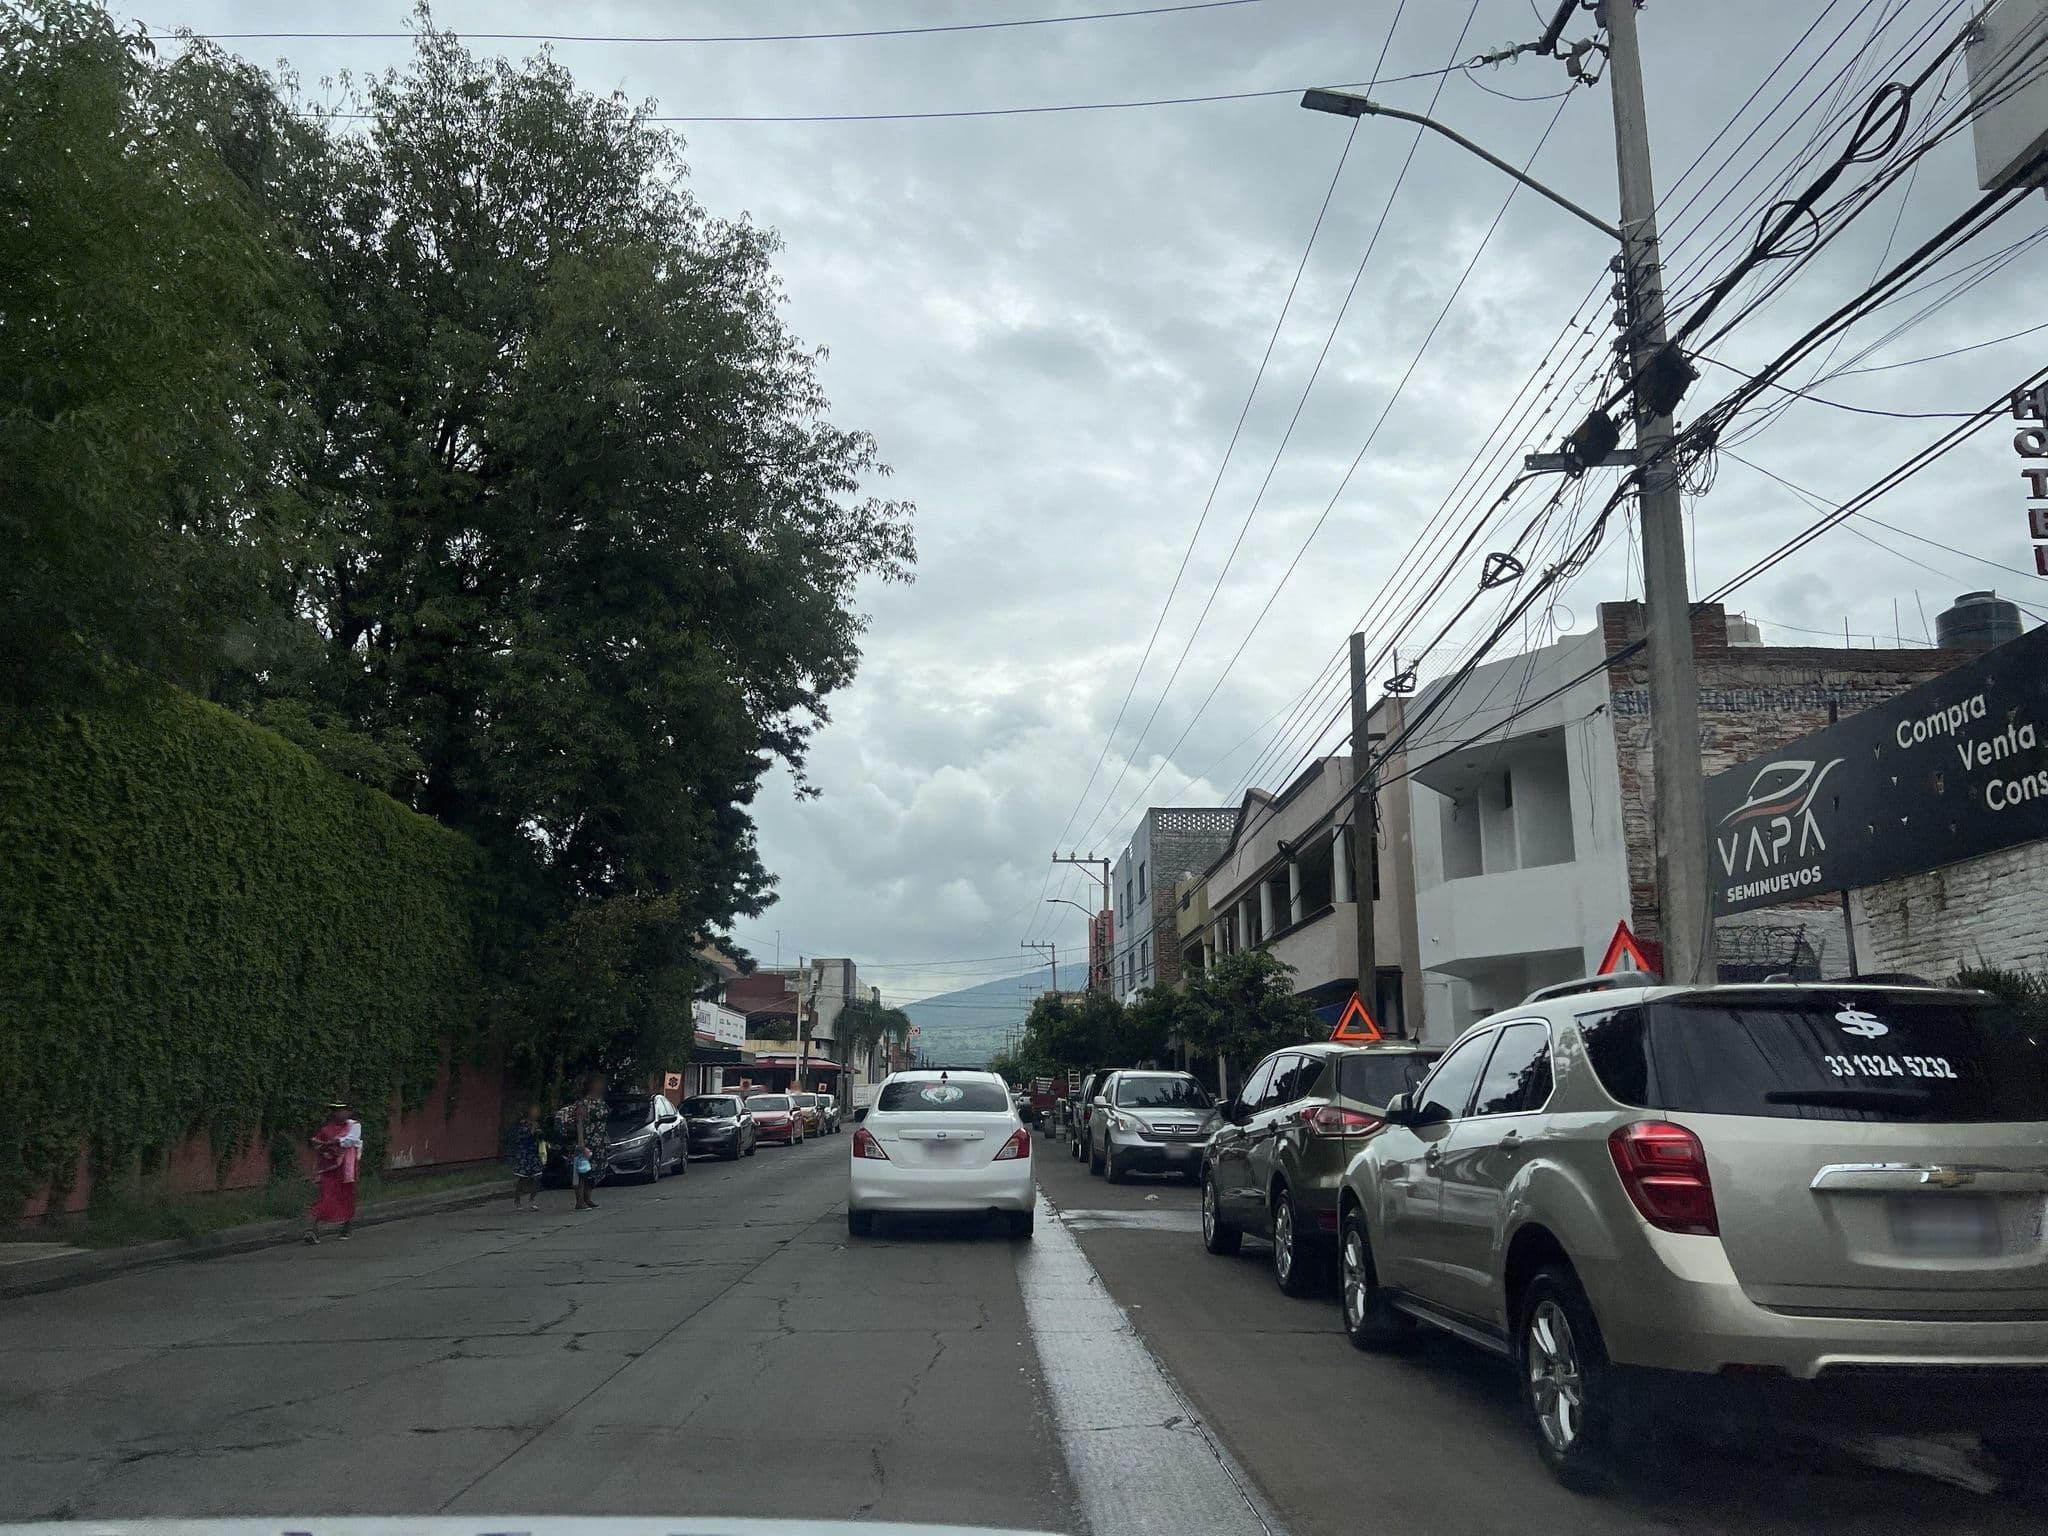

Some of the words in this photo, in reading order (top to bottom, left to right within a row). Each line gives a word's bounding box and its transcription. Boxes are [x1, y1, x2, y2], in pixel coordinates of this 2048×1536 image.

[1896, 694, 1987, 749] Compra
[1957, 723, 2036, 771] Venta
[1986, 770, 2048, 811] Cons
[1717, 807, 1826, 877] VAPA
[1727, 865, 1822, 903] SEMINUEVOS
[1903, 1055, 1957, 1078] 5232
